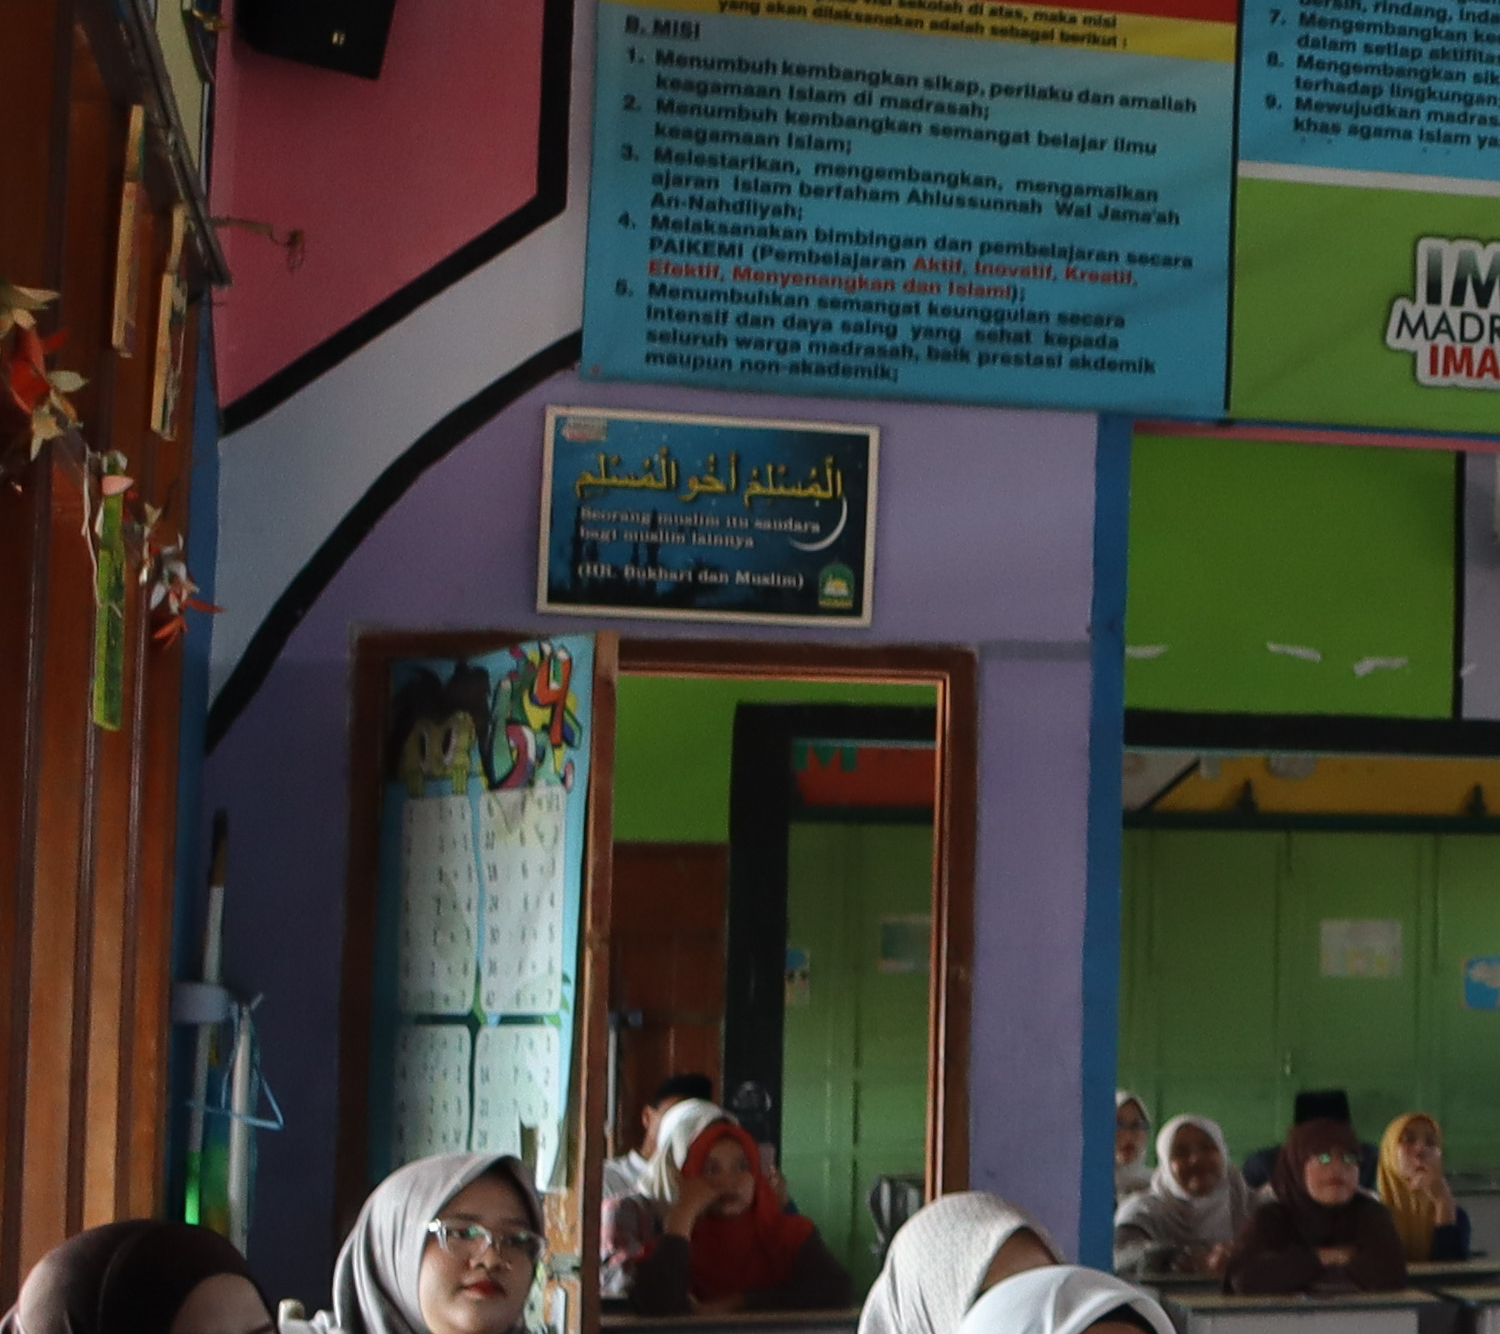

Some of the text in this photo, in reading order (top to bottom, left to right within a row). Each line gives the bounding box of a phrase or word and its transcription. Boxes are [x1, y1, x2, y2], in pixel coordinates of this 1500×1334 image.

[651, 18, 700, 41] MISI
[718, 0, 1117, 48] yang akan dilaksanakan adalah sebagai berikut
[967, 2, 983, 16] di
[1032, 10, 1077, 25] maka
[1081, 14, 1117, 29] misi
[1298, 11, 1467, 43] Mengembangkan
[1296, 32, 1357, 54] dalam
[1362, 41, 1422, 62] setiap
[655, 48, 777, 75] Menumbuh
[781, 59, 918, 88] kembangkan
[988, 82, 1073, 102] perilaku
[1076, 87, 1114, 106] dan
[1118, 94, 1196, 113] amaliah
[655, 72, 781, 100] keagamaan
[787, 84, 846, 105] Islam
[852, 89, 873, 106] di
[648, 236, 743, 259] PAIKEMI
[751, 243, 906, 272] (Pembelajaran
[649, 213, 807, 245] Melaksanakan
[814, 225, 927, 252] bimbingan
[933, 234, 972, 252] dan
[978, 240, 1119, 264] pembelajaran
[1125, 251, 1192, 269] secara
[732, 264, 896, 293] Menyenangkan
[901, 277, 941, 294] dan
[647, 280, 809, 309] Menumbuhkan
[816, 292, 920, 318] semangat
[926, 300, 1050, 324] keunggulan
[1056, 311, 1125, 328] secara
[623, 529, 687, 546] muslim
[697, 567, 729, 585] dan
